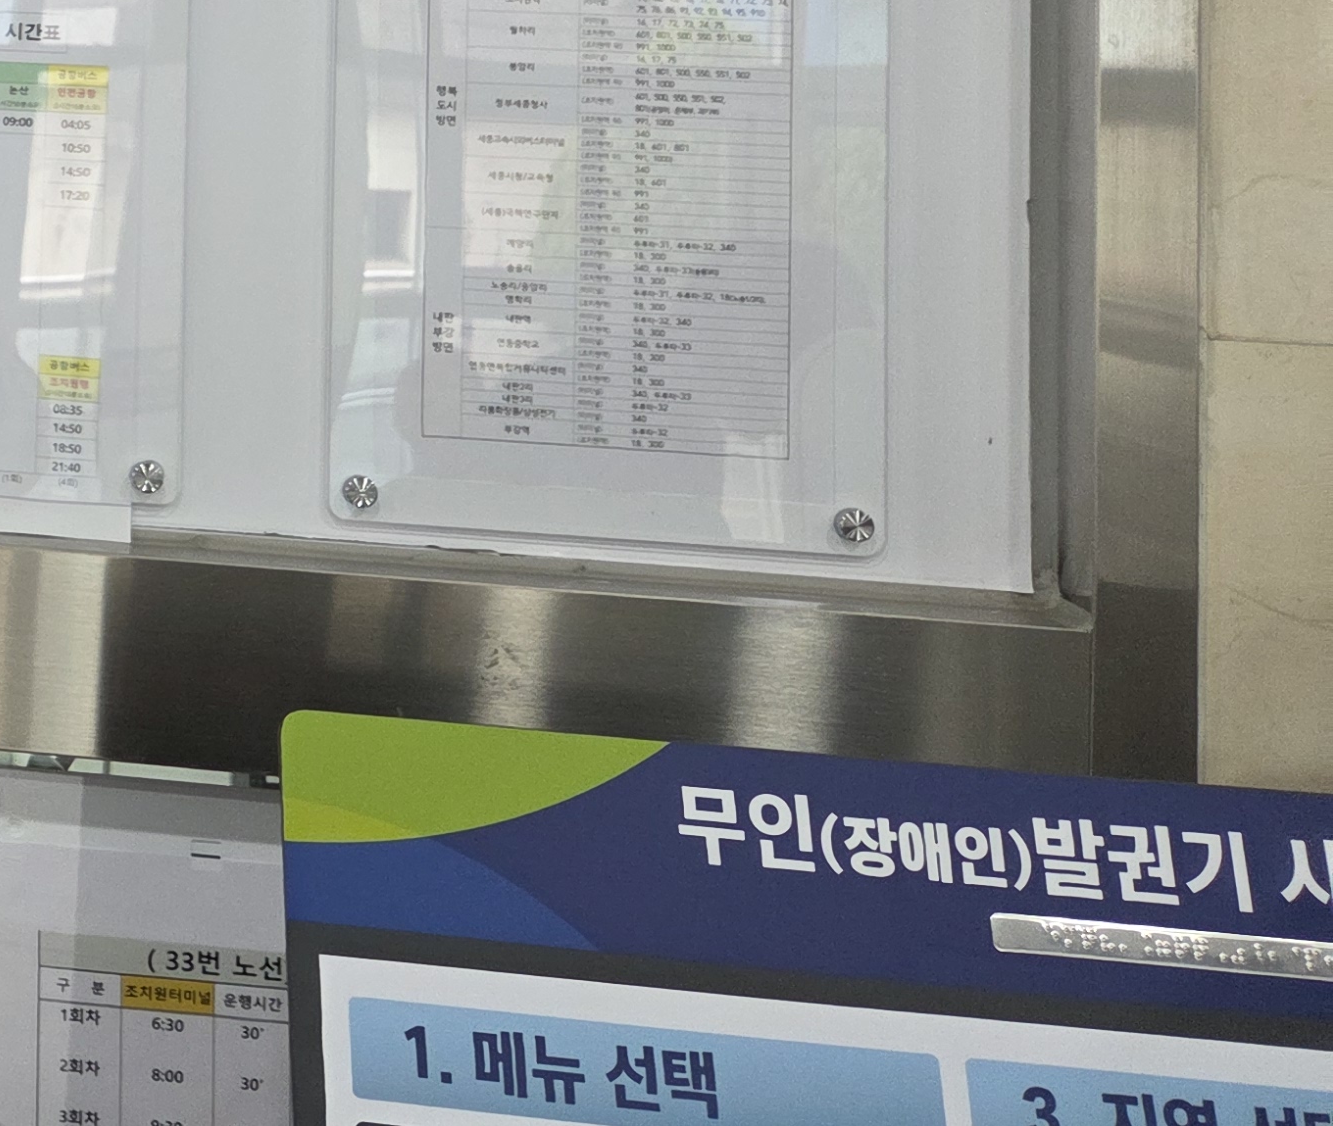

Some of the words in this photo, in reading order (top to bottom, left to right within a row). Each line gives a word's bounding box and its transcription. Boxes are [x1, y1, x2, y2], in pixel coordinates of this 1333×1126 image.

[4, 20, 62, 43] 시간표
[2, 116, 34, 128] 09:00
[60, 119, 92, 131] 04:05
[51, 461, 82, 473] 21:40
[677, 785, 1254, 913] 무인(장애인)발권기
[233, 954, 283, 981] 노선
[124, 984, 211, 1006] 조치원터미널
[223, 993, 283, 1013] 운행시간
[61, 1007, 101, 1026] 1회차
[151, 1016, 185, 1033] 6:30
[59, 1058, 101, 1077] 2회차
[151, 1068, 184, 1084] 8:00
[404, 1025, 453, 1085] 1.
[472, 1031, 586, 1106] 메뉴
[605, 1045, 719, 1120] 선택
